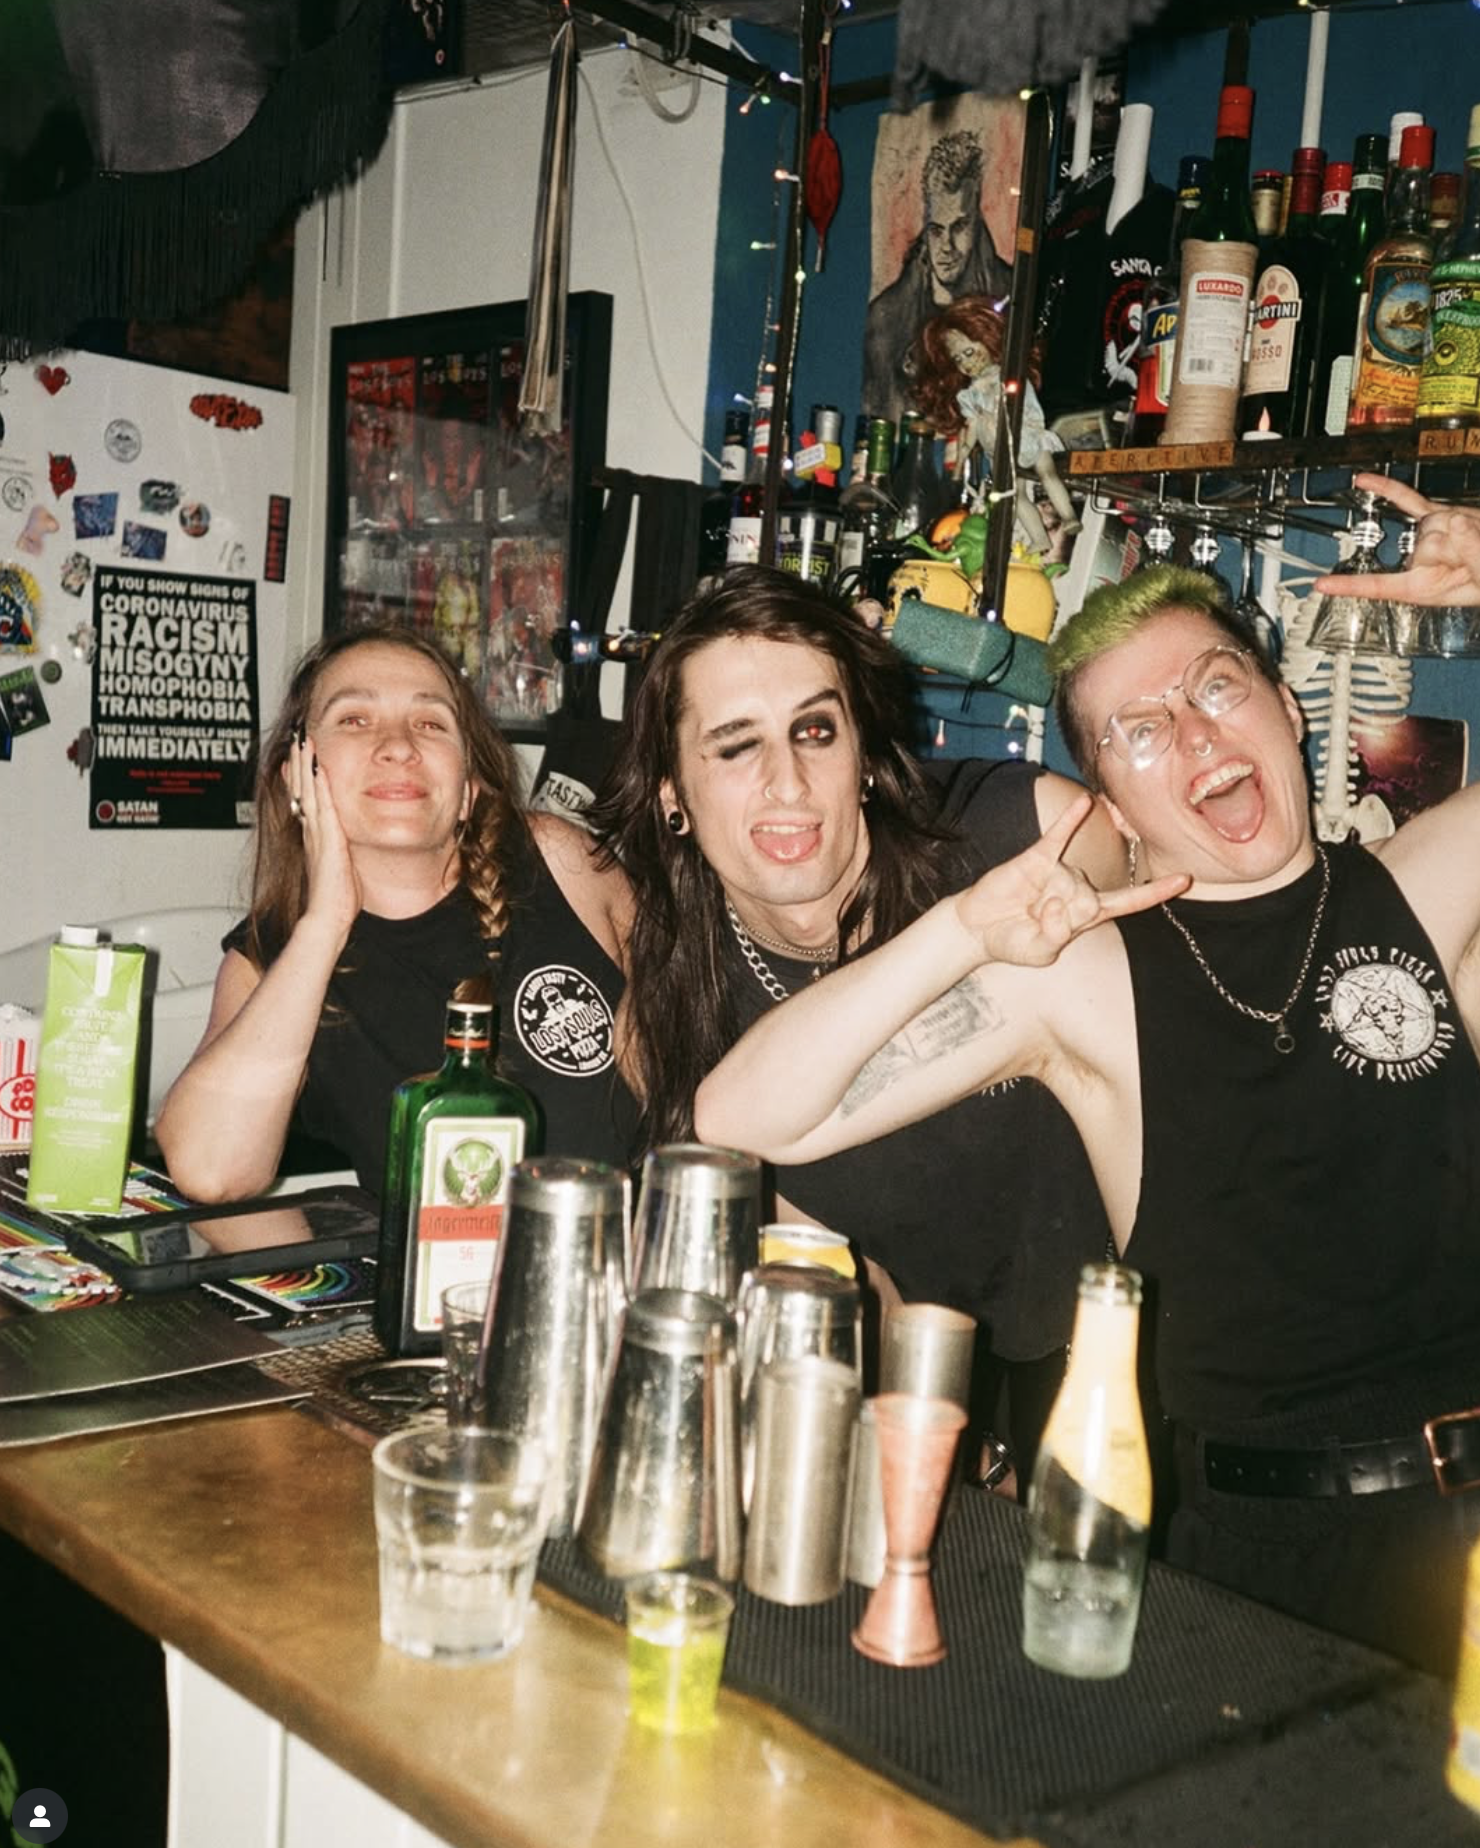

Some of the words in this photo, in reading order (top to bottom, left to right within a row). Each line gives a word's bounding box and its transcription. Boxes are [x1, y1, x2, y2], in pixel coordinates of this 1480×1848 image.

[1110, 258, 1152, 277] SANTA
[1197, 280, 1243, 294] LUXARDO
[1434, 288, 1463, 310] 1825
[1153, 311, 1178, 338] AP
[1254, 303, 1297, 320] ARTINI
[100, 574, 115, 588] IF
[117, 576, 145, 591] YOU
[147, 578, 188, 595] SHOW
[190, 582, 230, 598] SIGNS
[232, 586, 250, 600] OF
[99, 593, 250, 622] CORONAVIRUS
[100, 613, 249, 655] RACISM
[99, 647, 250, 680] MISOGYNY
[98, 673, 251, 700] HOMOPHOBIA
[97, 696, 252, 722] TRANSPHOBIA
[97, 723, 127, 735] THEN
[129, 725, 157, 737] TAKE
[158, 726, 215, 739] YOURSELF
[216, 728, 251, 740] HOME
[97, 736, 251, 762] IMMEDIATELY
[116, 800, 159, 813] SATAN
[546, 778, 588, 809] TASTY
[541, 971, 566, 985] TASTY
[1314, 964, 1337, 1003] LOST
[1334, 945, 1380, 969] SOULS
[1390, 947, 1437, 984] PIZZA
[529, 1023, 572, 1056] LOST
[563, 998, 609, 1041] SOULS
[569, 1035, 602, 1061] PIZZA
[13, 1078, 35, 1095] PO
[11, 1095, 34, 1112] CO
